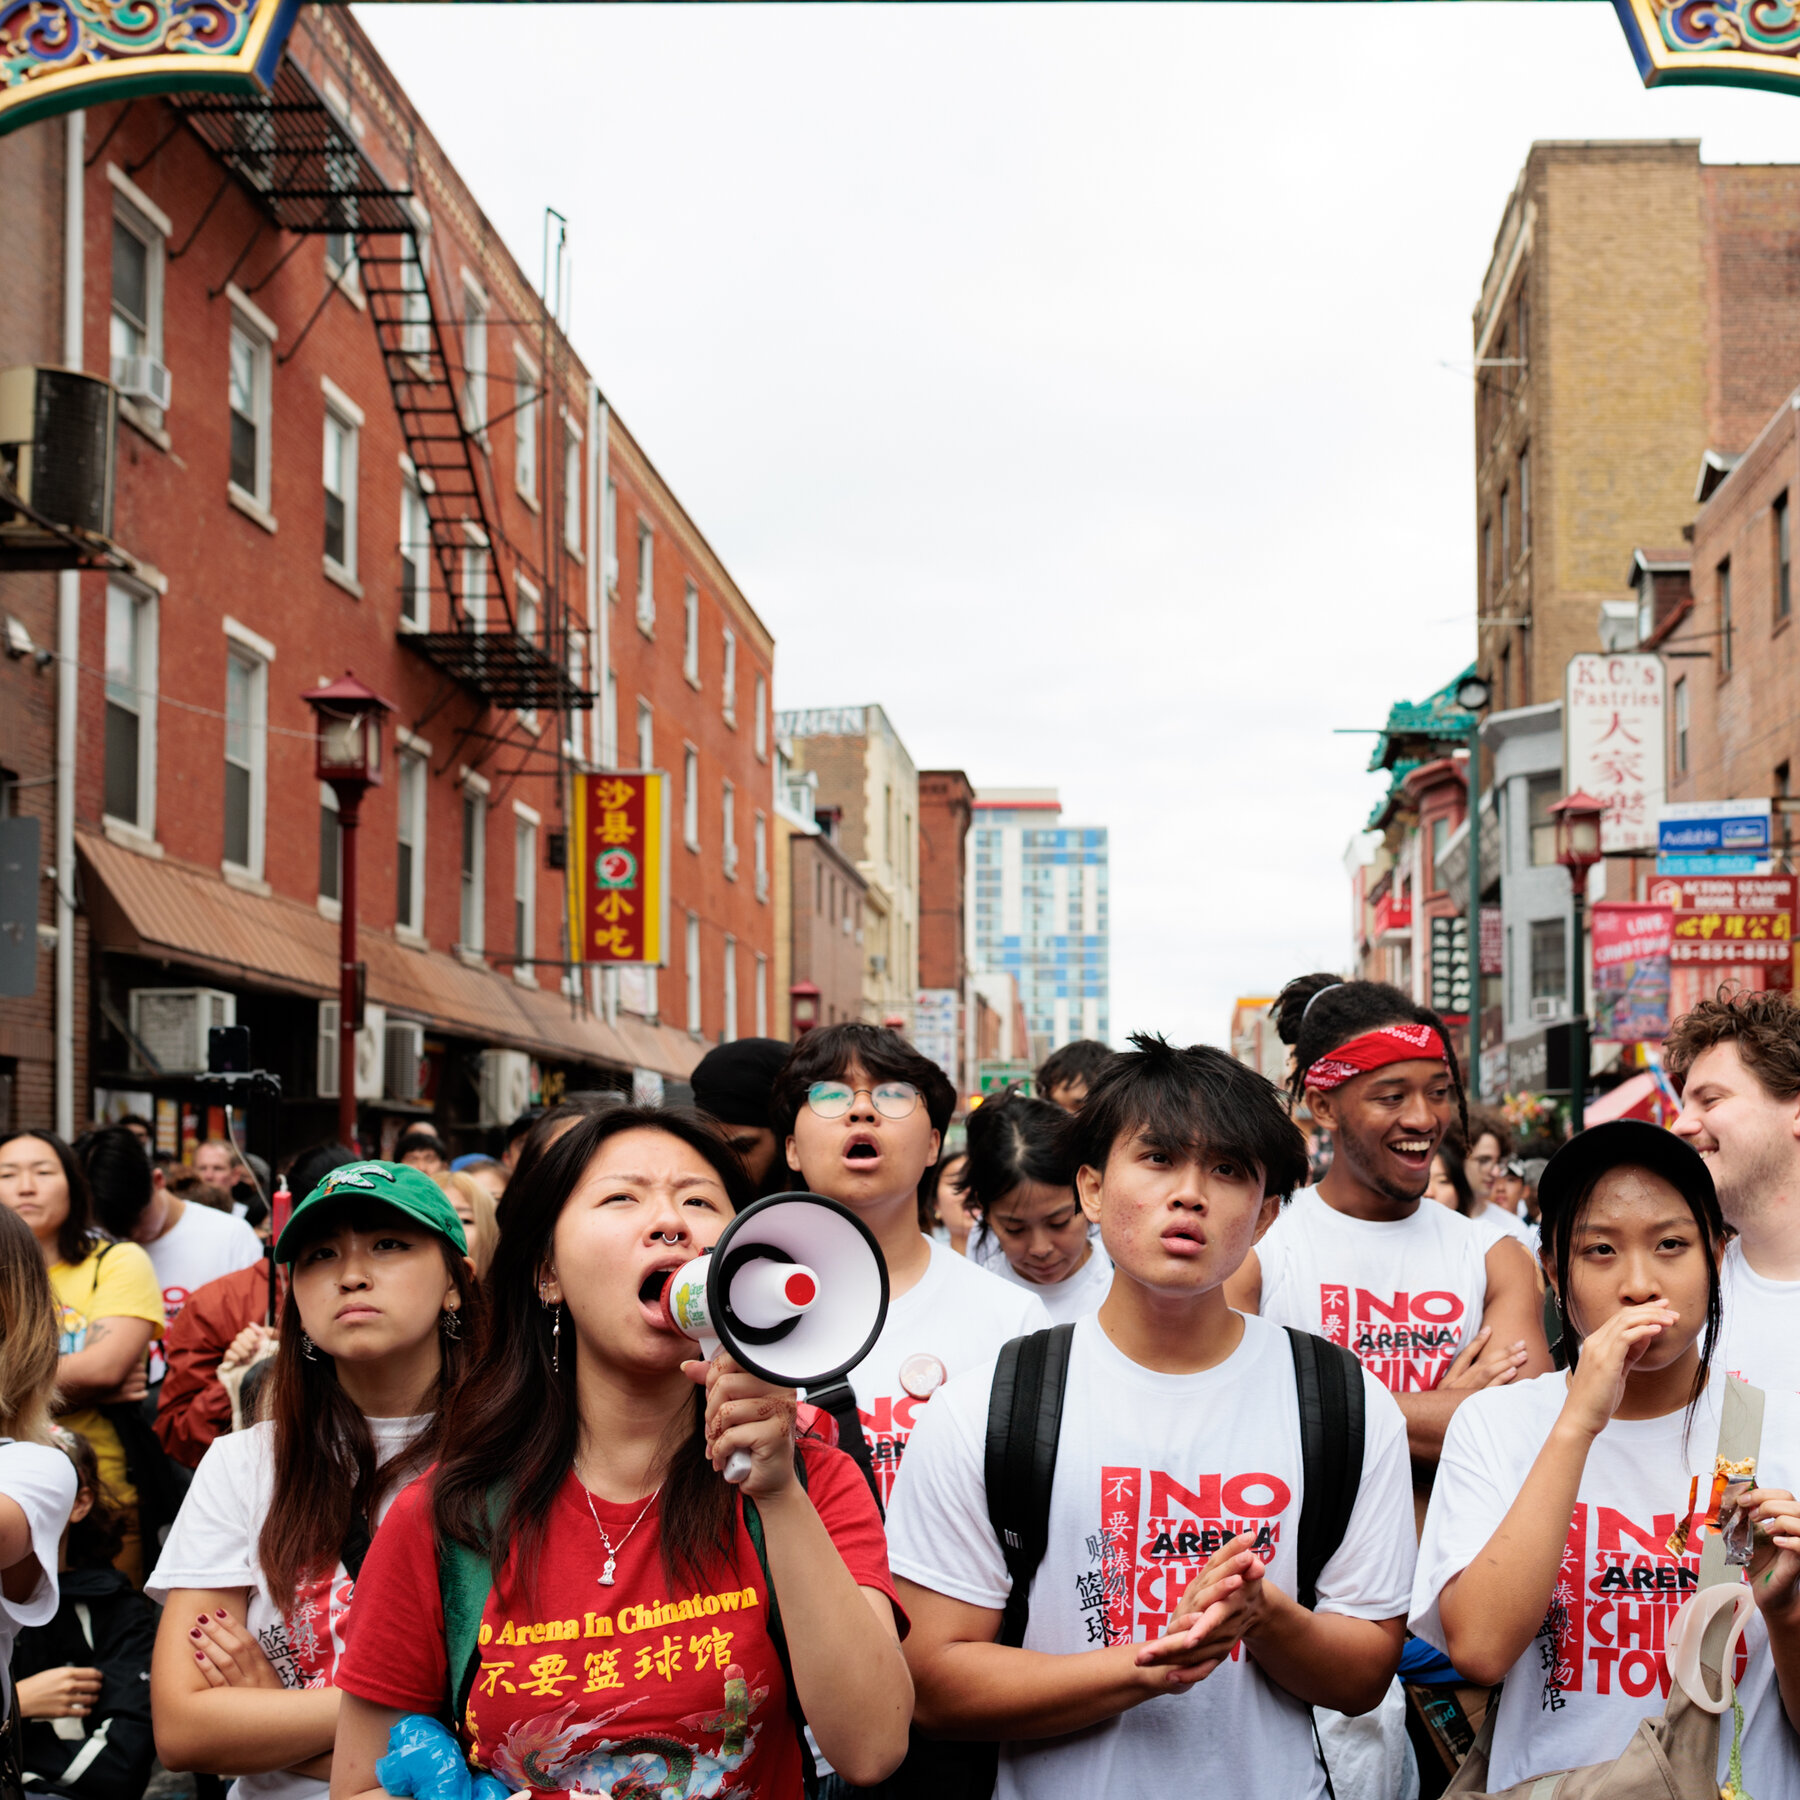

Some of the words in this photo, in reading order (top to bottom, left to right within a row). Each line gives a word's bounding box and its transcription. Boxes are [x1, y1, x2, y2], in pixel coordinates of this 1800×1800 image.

[1578, 660, 1655, 684] K.C.'s
[1573, 689, 1660, 706] Pastries
[595, 778, 637, 844] 沙县
[1683, 881, 1735, 897] ACTION
[1737, 880, 1791, 897] SENIOR
[1694, 896, 1735, 909] HOME
[1739, 895, 1777, 909] CARE
[595, 890, 634, 958] 小吃
[1322, 1289, 1345, 1346] 不要
[1355, 1288, 1464, 1324] NO
[1359, 1330, 1455, 1350] ARENA
[1150, 1470, 1291, 1519] NO
[1600, 1566, 1699, 1589] AREN
[478, 1619, 493, 1646] o
[495, 1619, 580, 1646] Arena
[583, 1611, 613, 1638] In
[617, 1586, 760, 1635] Chinatown
[479, 1626, 734, 1698] 不要篮球馆
